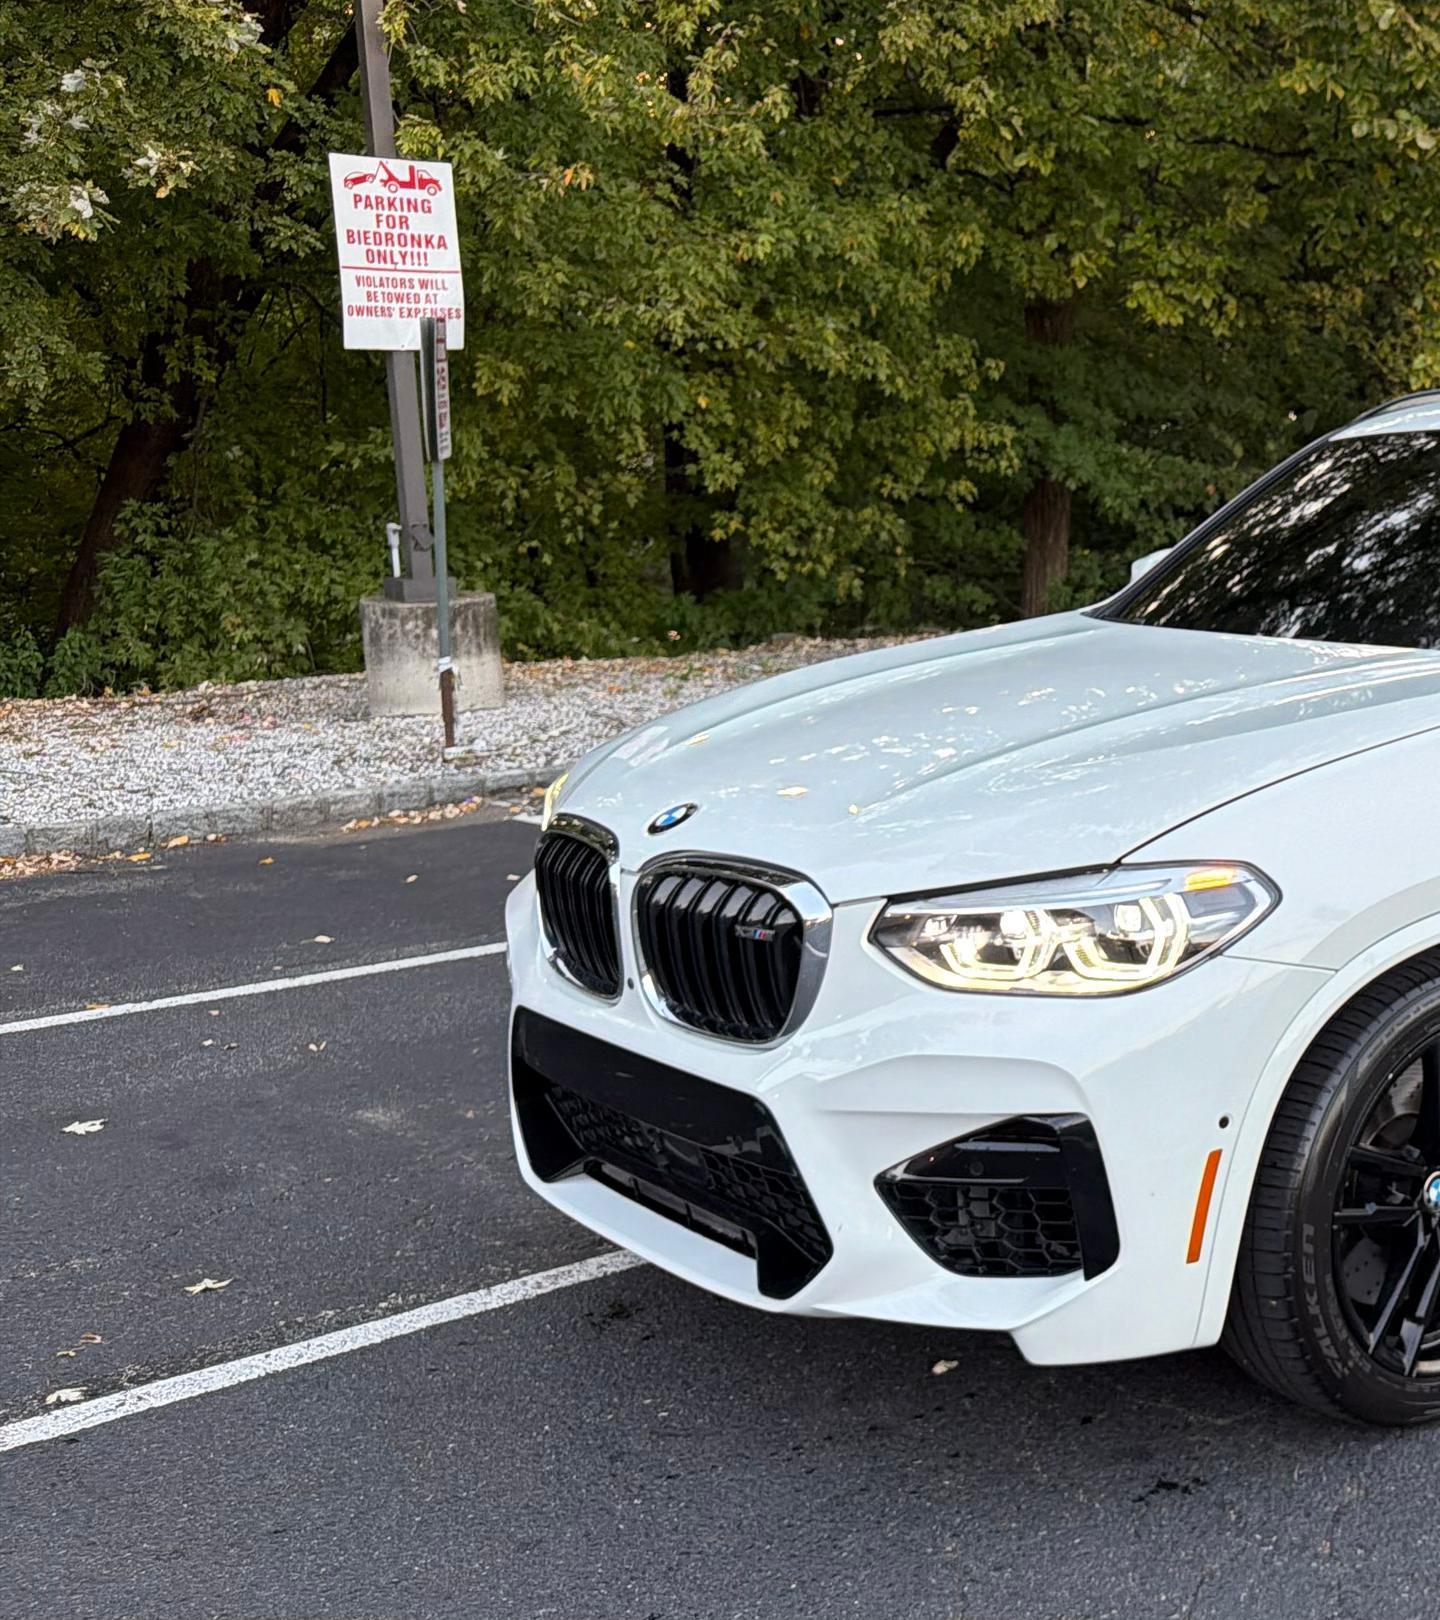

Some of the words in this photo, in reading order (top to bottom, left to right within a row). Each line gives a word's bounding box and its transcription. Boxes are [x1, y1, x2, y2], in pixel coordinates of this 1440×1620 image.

[353, 193, 433, 214] PARKING
[375, 213, 410, 230] FOR
[346, 229, 448, 250] BIEDRONKA
[365, 248, 429, 266] ONLY!!!
[355, 275, 415, 290] VIOLATORS
[418, 278, 448, 291] WILL
[366, 291, 380, 303] BE
[381, 291, 421, 305] TOWED
[424, 293, 438, 304] AT
[347, 304, 395, 318] OWNERS'
[399, 306, 462, 320] EXPENSES
